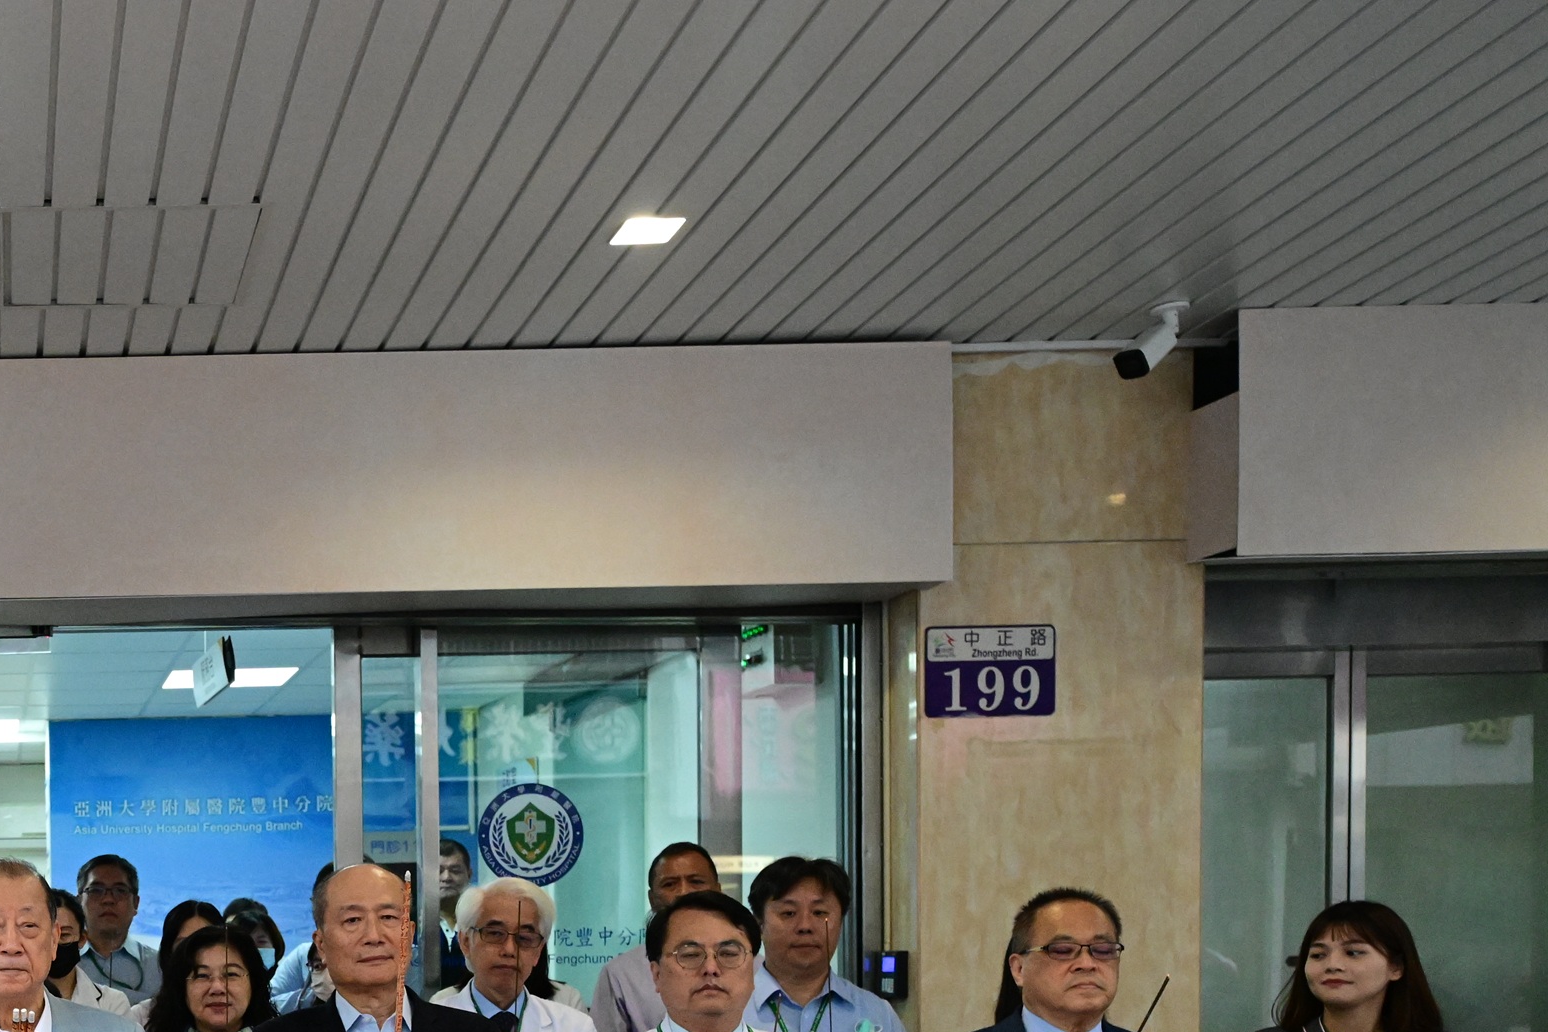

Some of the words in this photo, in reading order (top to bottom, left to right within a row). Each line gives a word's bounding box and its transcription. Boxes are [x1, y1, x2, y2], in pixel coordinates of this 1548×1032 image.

[964, 628, 1047, 647] 中正路
[972, 648, 1023, 660] Zhongzheng
[1024, 647, 1040, 657] Rd.
[944, 665, 1041, 712] 199
[73, 795, 334, 818] 亞洲大學附屬醫院豐中分院
[74, 824, 98, 835] Asia
[100, 823, 153, 837] University
[156, 822, 201, 835] Hospital
[203, 822, 262, 835] Fengchung
[265, 820, 304, 832] Branch
[482, 845, 496, 868] ASIA
[548, 843, 581, 881] HOSPITAL
